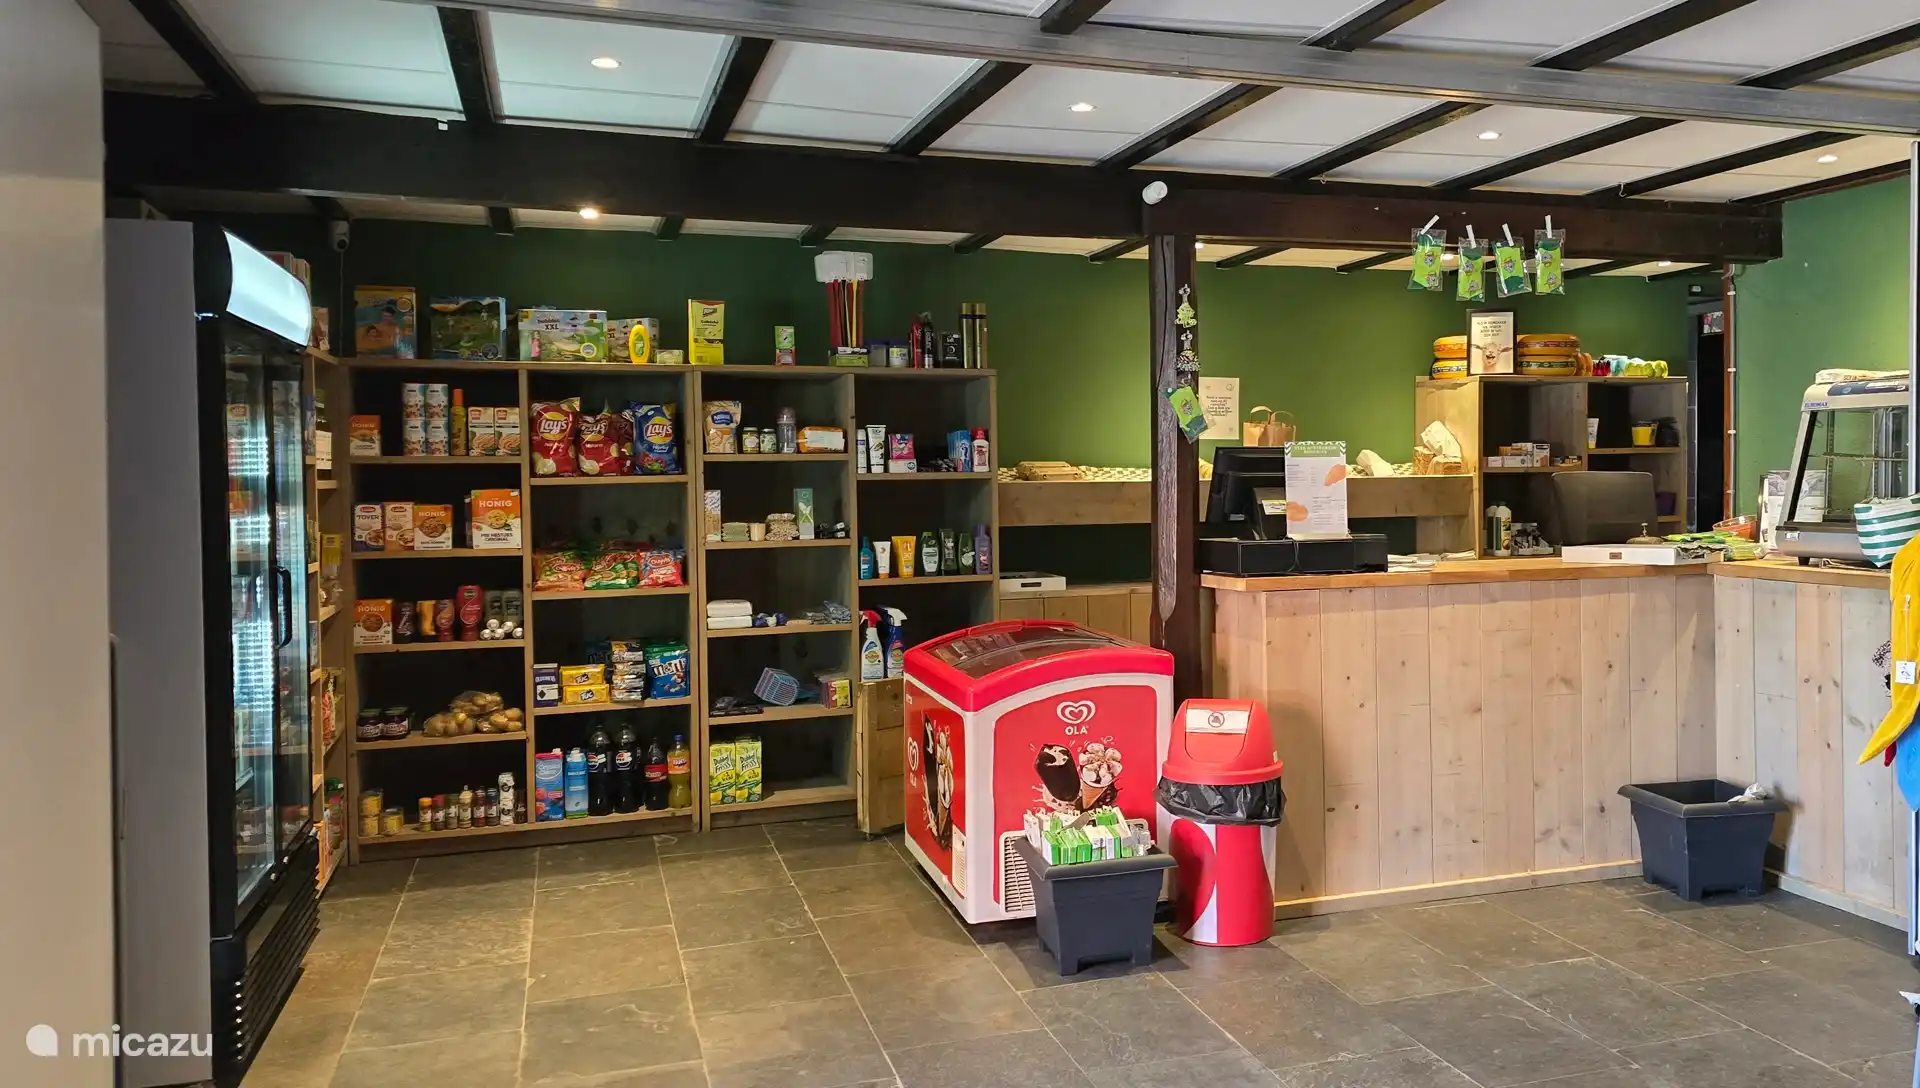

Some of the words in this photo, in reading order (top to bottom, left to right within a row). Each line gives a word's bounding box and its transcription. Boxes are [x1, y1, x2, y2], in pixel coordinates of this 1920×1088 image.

[544, 323, 560, 331] XXL
[540, 419, 567, 435] Lay's
[646, 424, 673, 438] Lay's
[479, 500, 513, 508] HONIG
[1064, 725, 1088, 736] OLA
